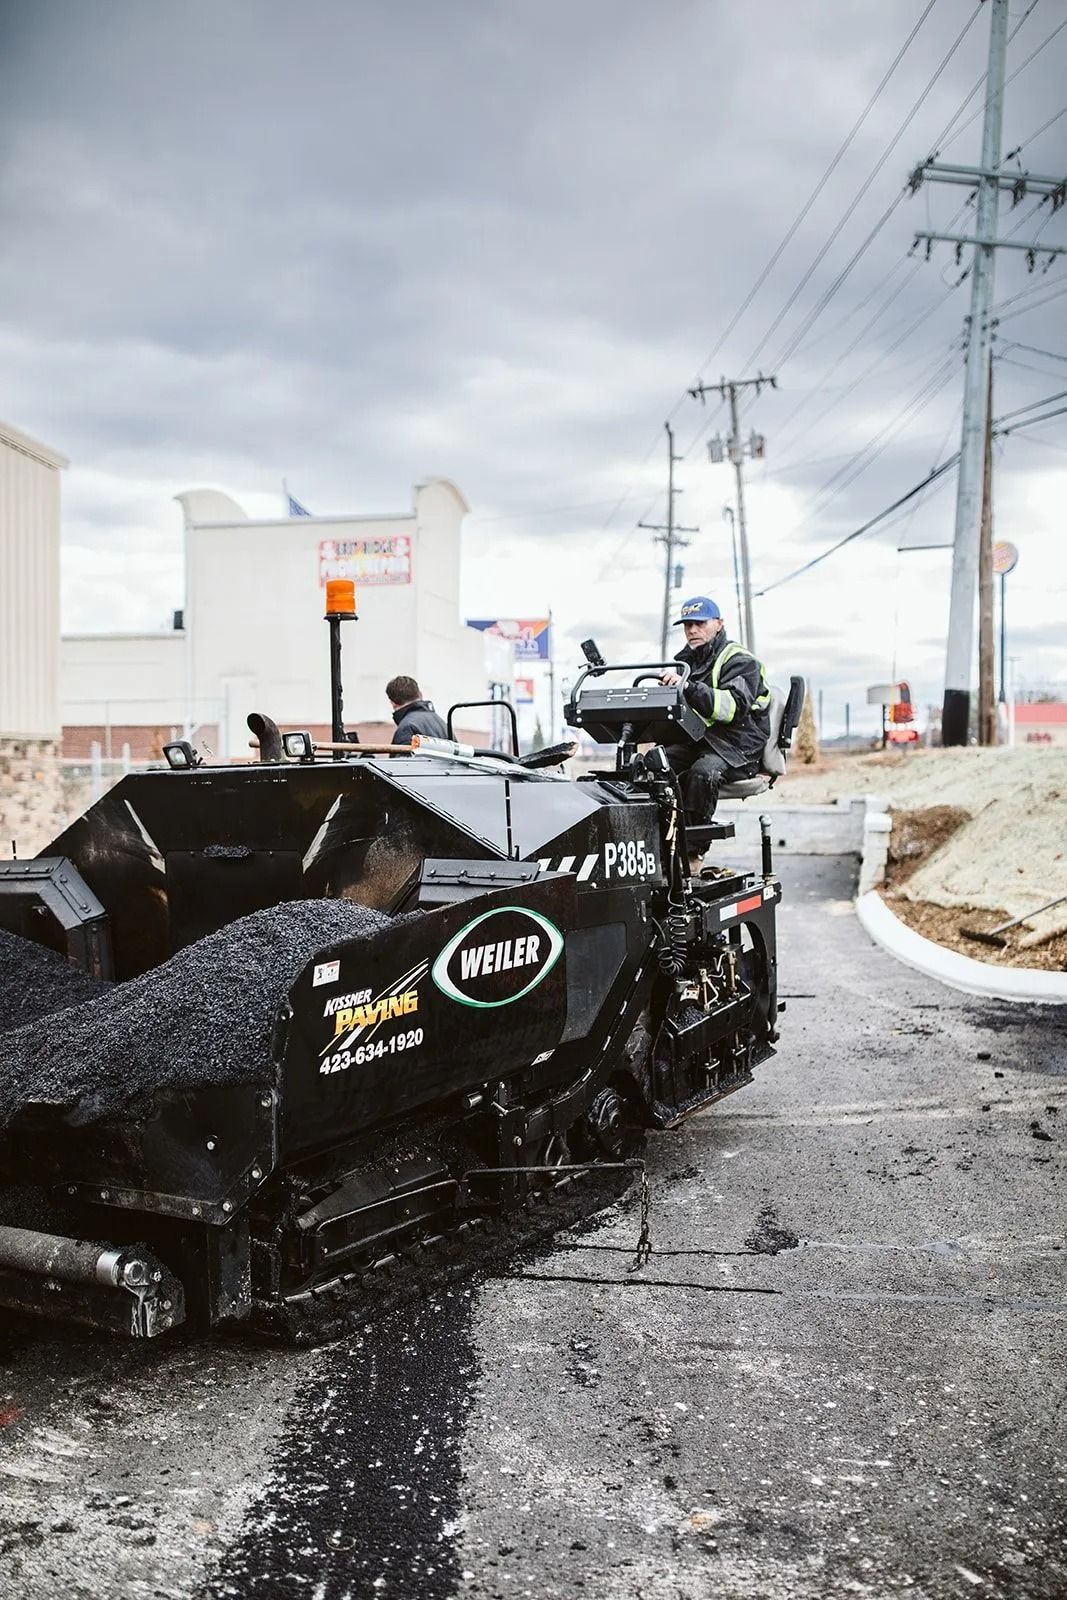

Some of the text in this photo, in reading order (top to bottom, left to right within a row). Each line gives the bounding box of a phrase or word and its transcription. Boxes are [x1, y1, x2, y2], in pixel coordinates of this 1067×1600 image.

[604, 840, 656, 879] P385B
[461, 934, 541, 981] WEILER
[323, 988, 373, 1018] KISSNER
[334, 989, 419, 1036] PAVING
[319, 1027, 425, 1075] 423-634-1920
